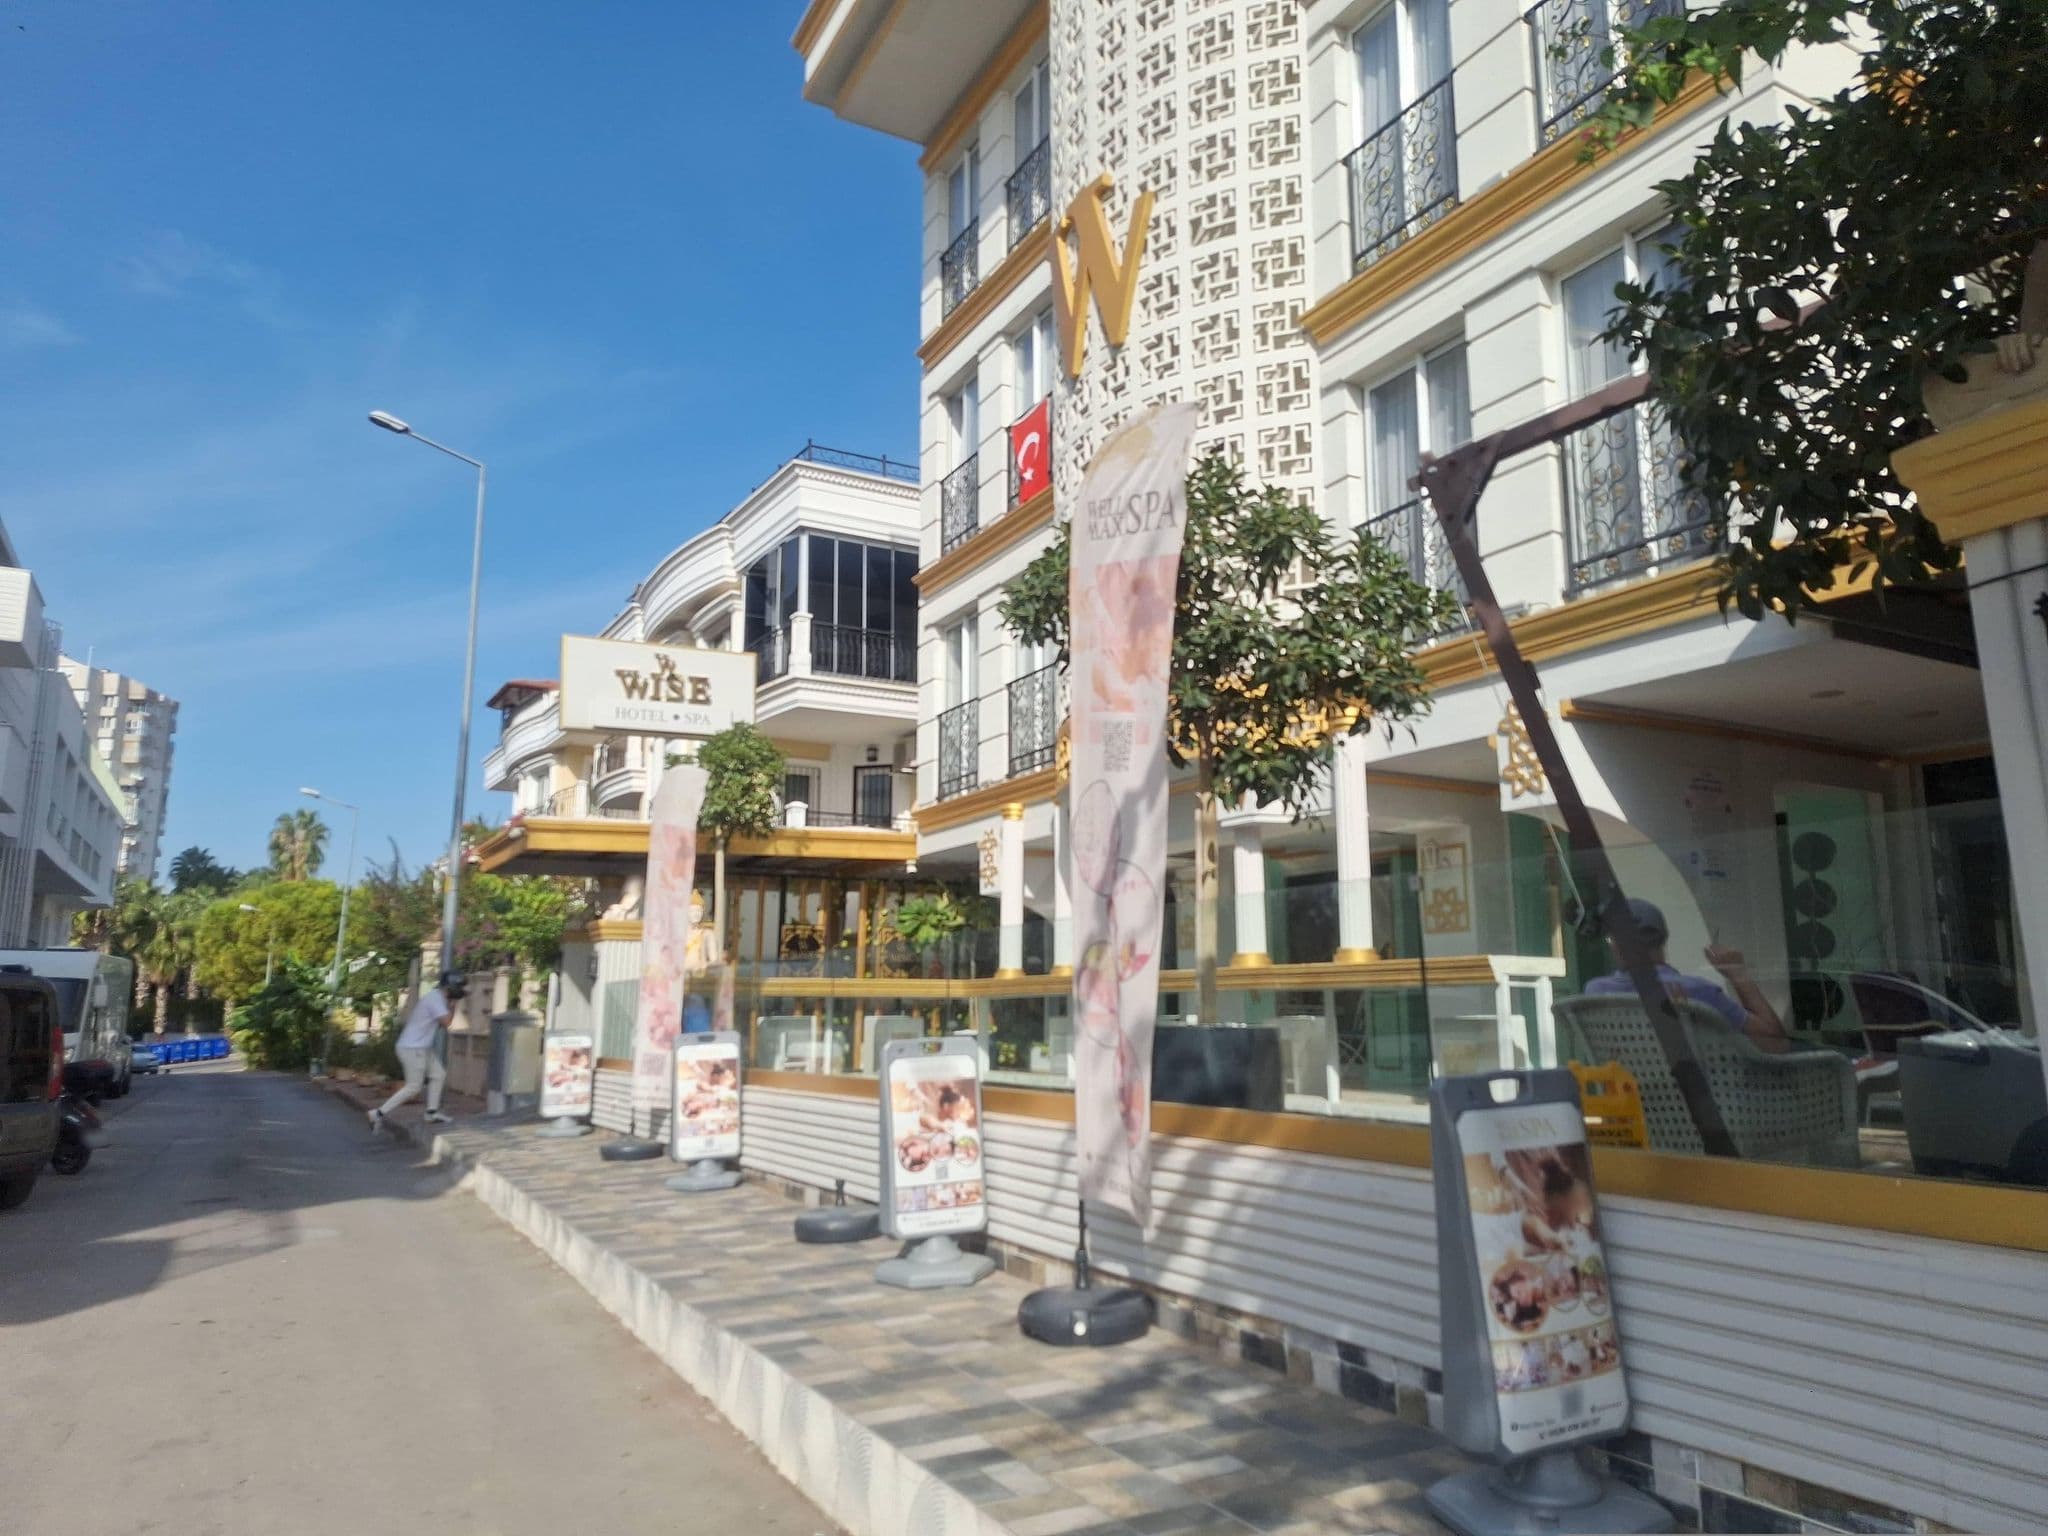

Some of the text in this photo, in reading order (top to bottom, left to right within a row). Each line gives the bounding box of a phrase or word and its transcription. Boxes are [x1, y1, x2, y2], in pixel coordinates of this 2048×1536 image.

[1048, 172, 1156, 379] W
[1126, 488, 1177, 534] SPA
[614, 669, 712, 705] WISE
[615, 706, 711, 726] HOTEL SPA
